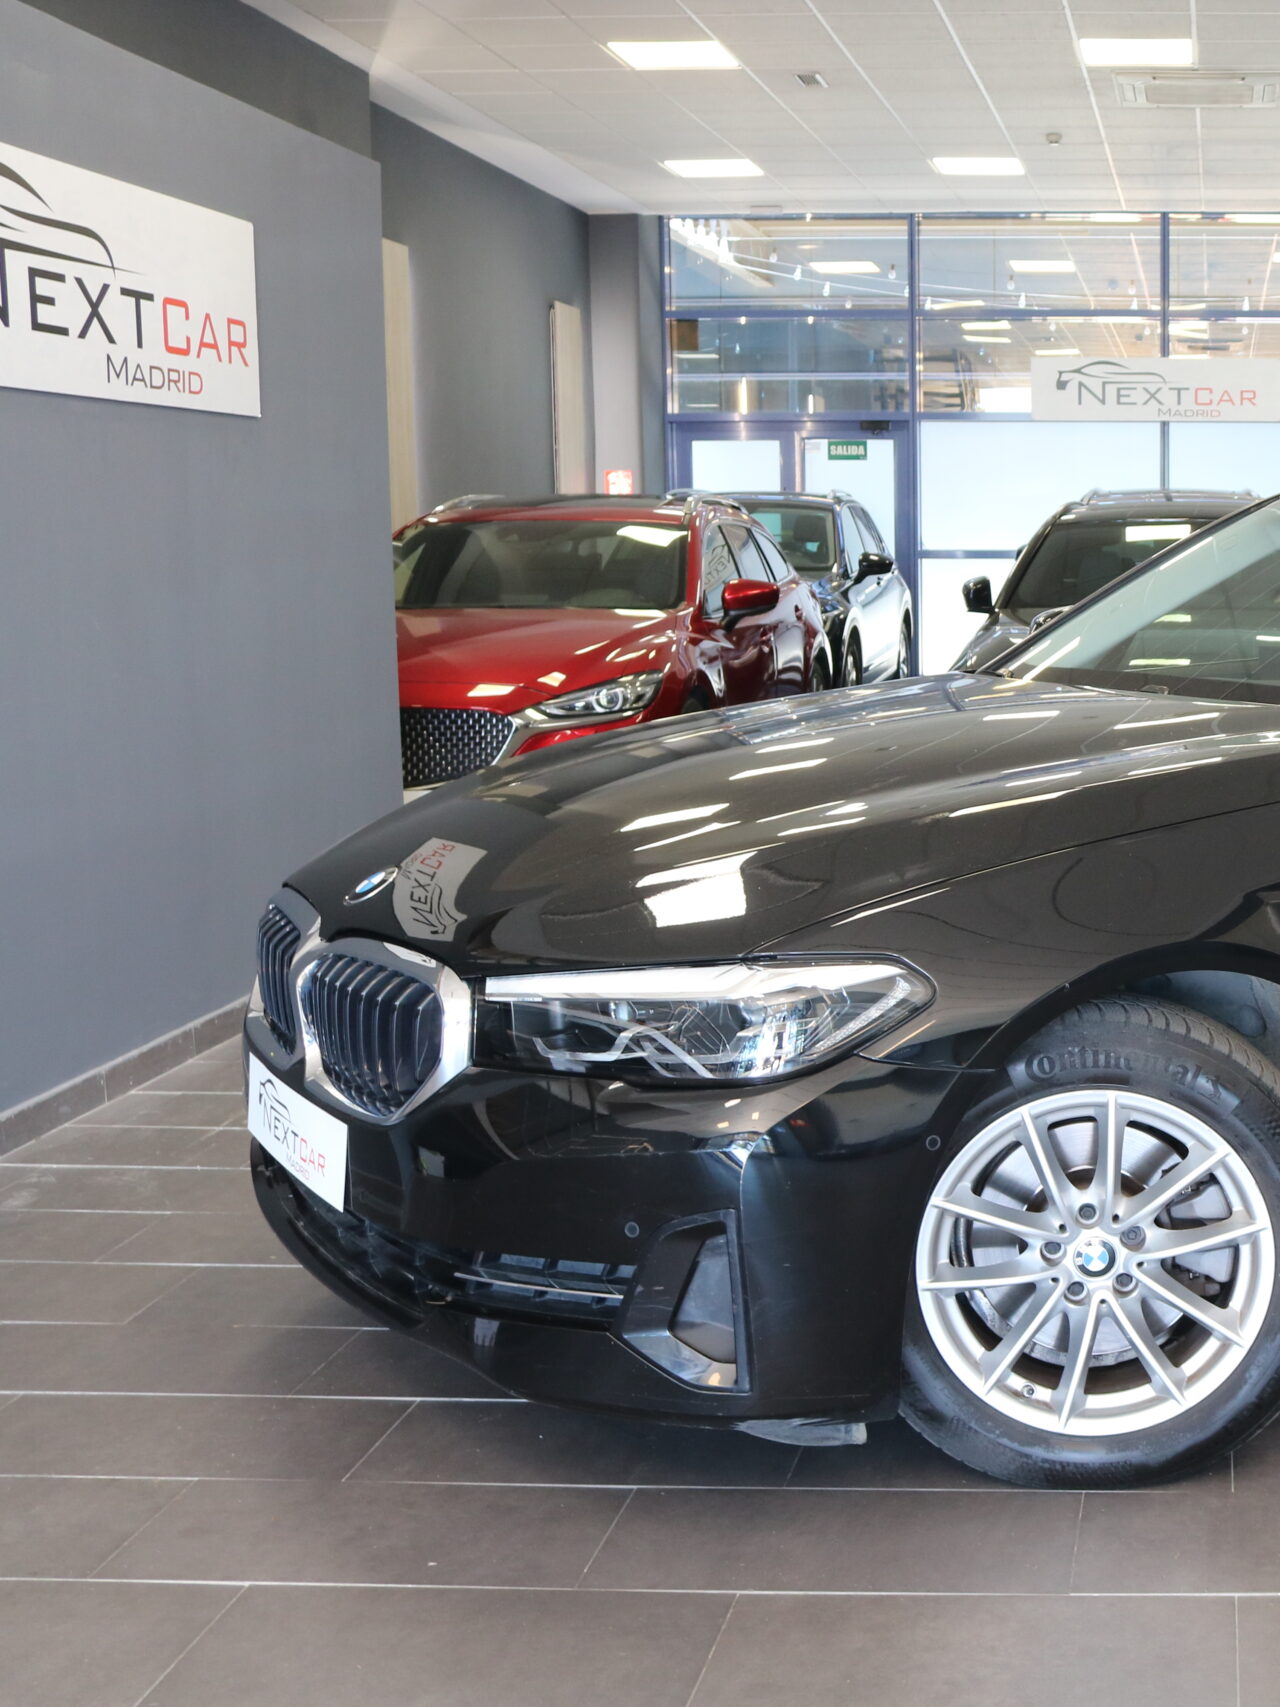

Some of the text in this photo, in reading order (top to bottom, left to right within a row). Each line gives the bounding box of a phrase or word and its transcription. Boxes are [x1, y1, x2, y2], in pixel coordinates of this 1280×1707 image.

[0, 242, 249, 367] EXTCAR
[106, 353, 204, 395] MADRID
[1078, 381, 1257, 406] NEXTCAR
[1158, 408, 1221, 418] MADRID
[830, 445, 865, 455] SALIDA
[263, 1099, 326, 1177] NEXTCAR
